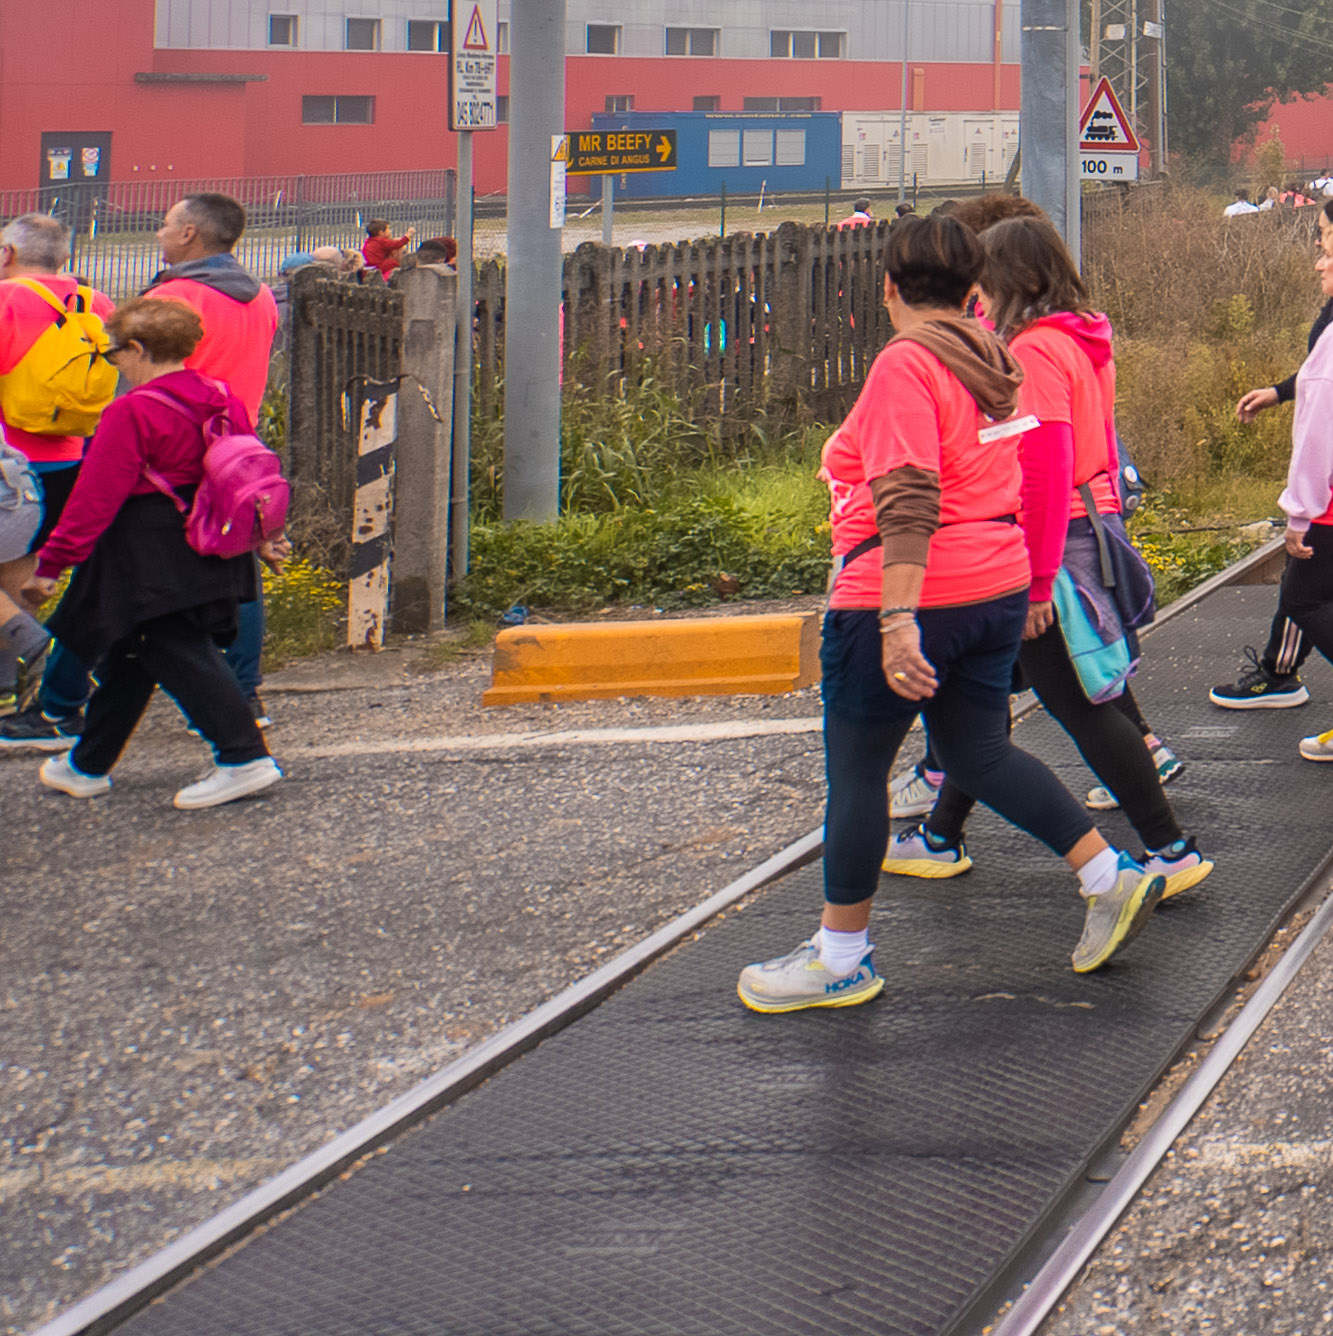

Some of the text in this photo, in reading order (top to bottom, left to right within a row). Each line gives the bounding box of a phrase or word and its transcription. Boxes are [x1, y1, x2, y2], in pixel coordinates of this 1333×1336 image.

[578, 133, 652, 152] MR BEEFY
[578, 154, 650, 167] CARNE DI ANGUS
[1082, 159, 1123, 174] 100 m
[825, 971, 865, 995] HOKA
